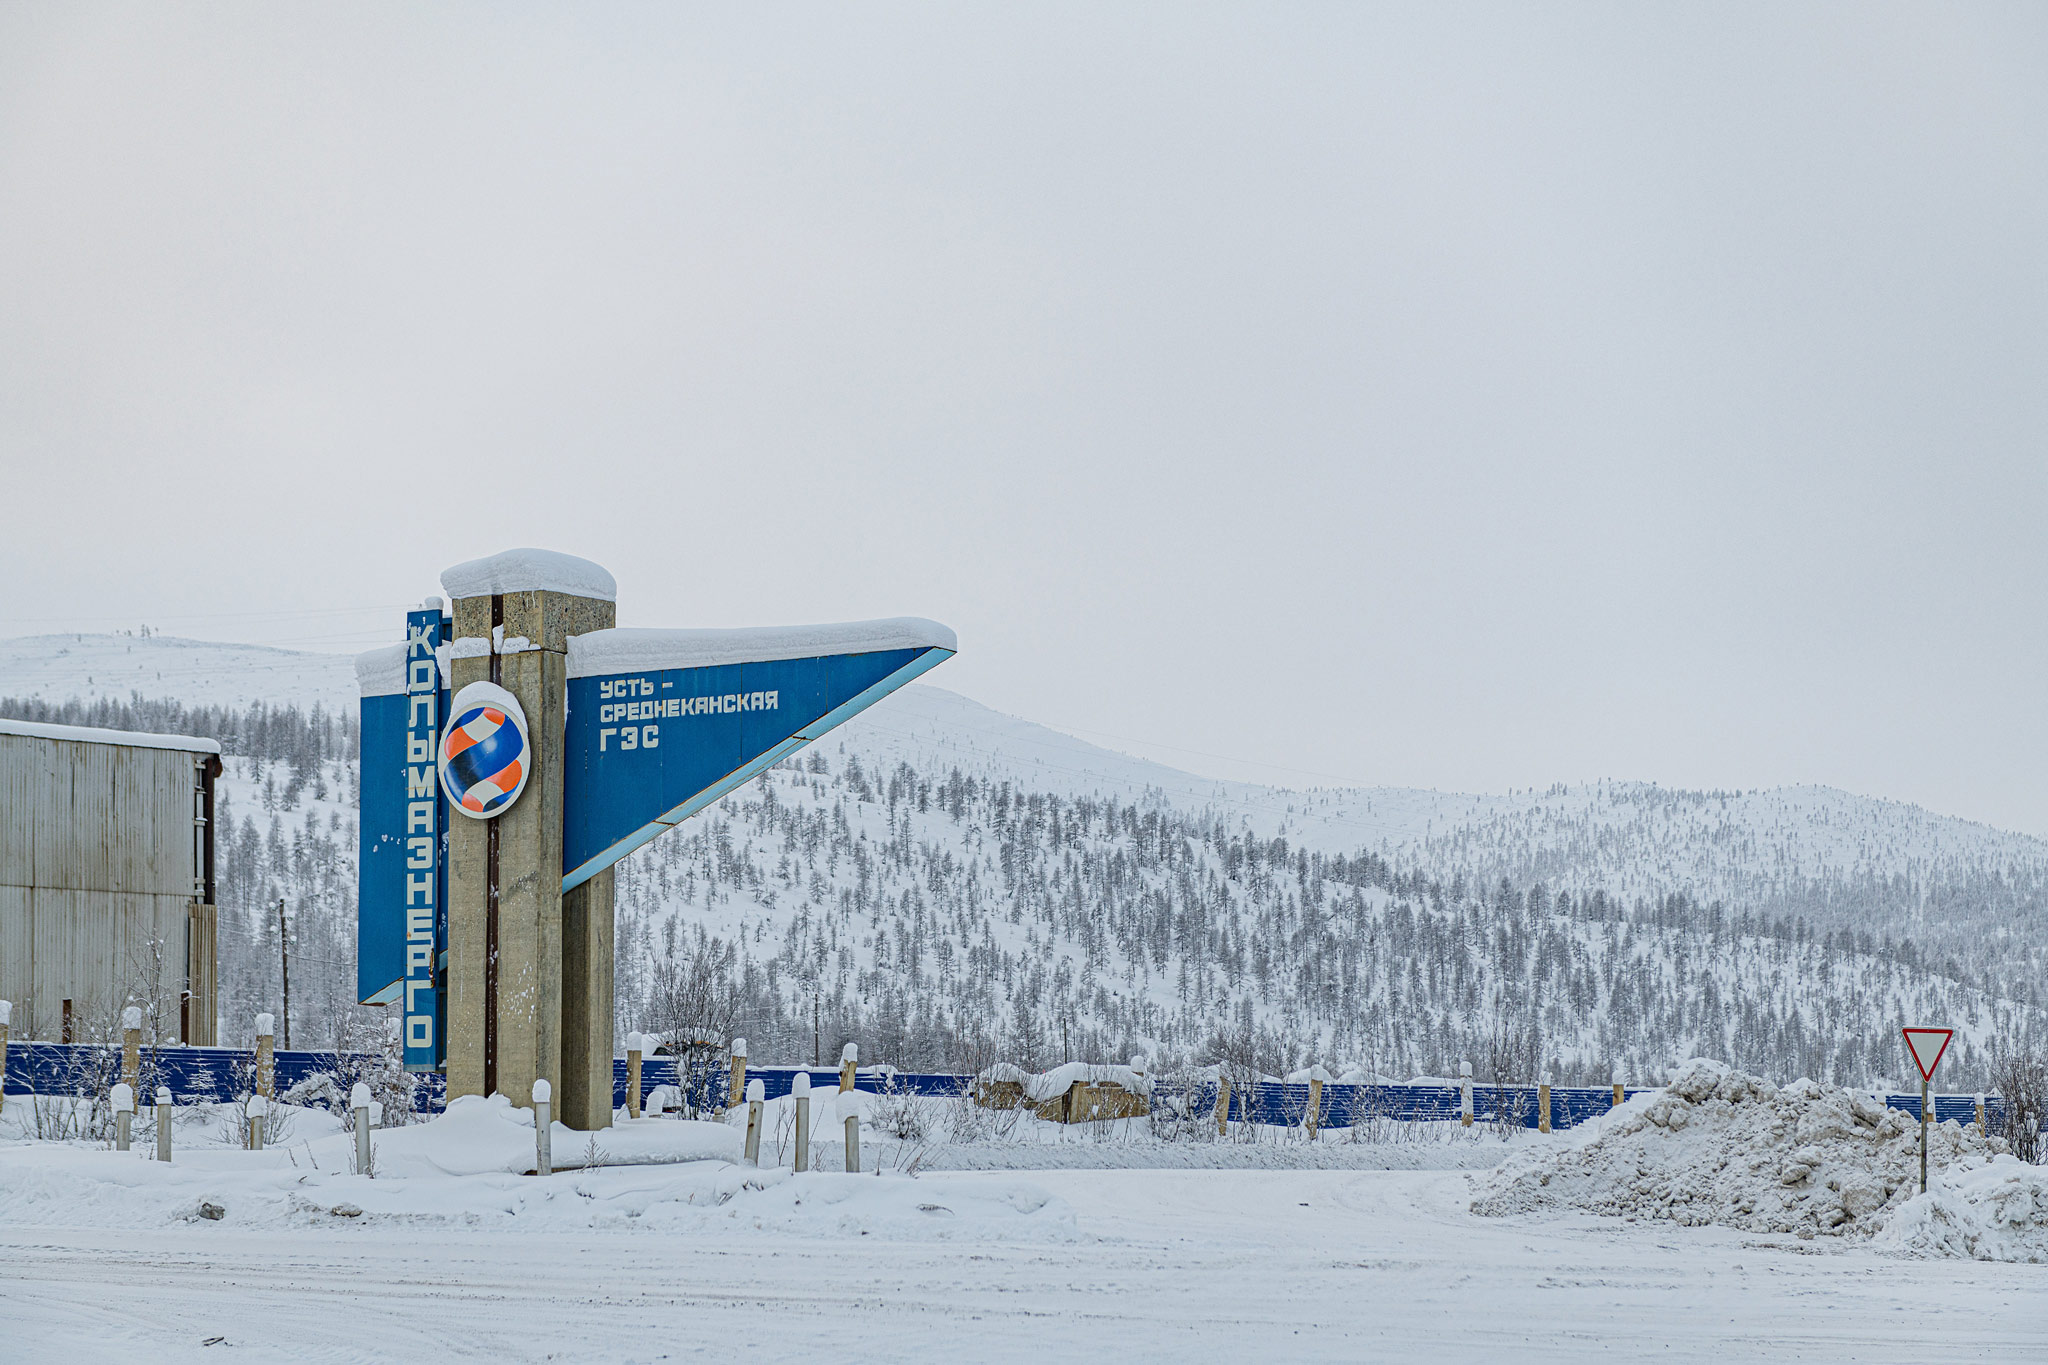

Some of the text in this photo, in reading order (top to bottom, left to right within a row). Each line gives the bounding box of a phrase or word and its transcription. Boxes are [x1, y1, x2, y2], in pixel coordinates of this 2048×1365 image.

[600, 678, 654, 699] УСТЬ
[600, 690, 779, 723] СРЕДНЕКАНСКАЯ
[600, 725, 659, 751] ГЭС
[406, 624, 435, 1048] КОЛЫМАЭНЕРГО
